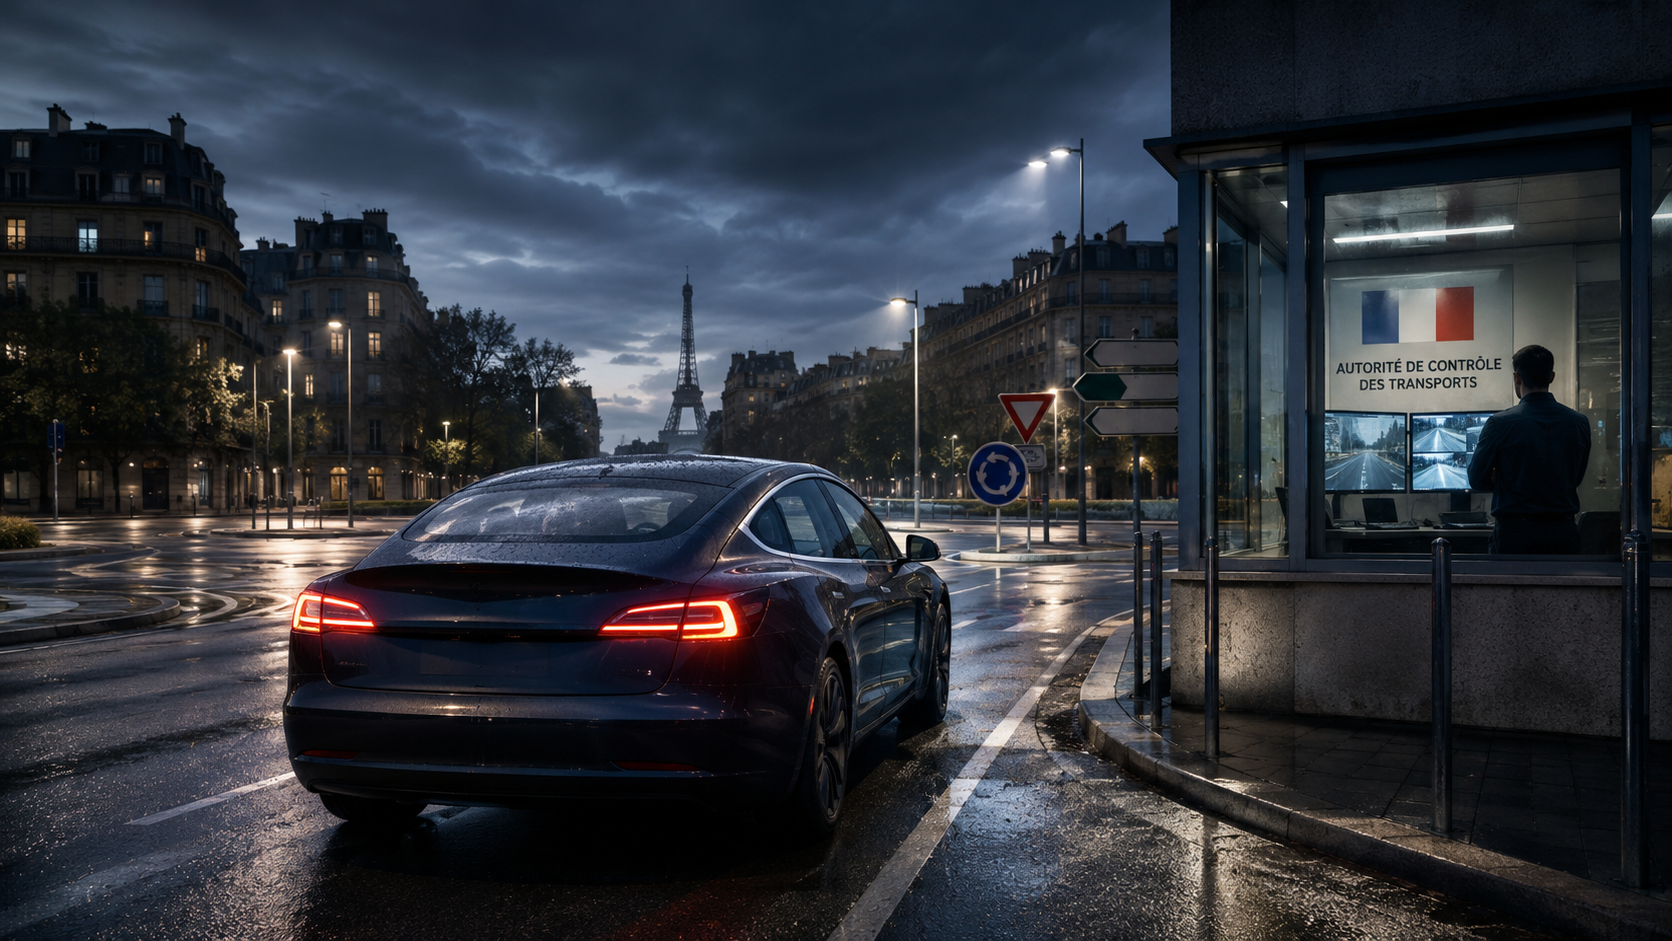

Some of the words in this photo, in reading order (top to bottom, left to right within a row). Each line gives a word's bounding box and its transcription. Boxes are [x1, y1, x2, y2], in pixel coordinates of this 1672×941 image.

[1336, 358, 1402, 374] AUTORITÉ
[1406, 360, 1424, 373] DE
[1428, 356, 1502, 372] CONTRÔLE
[1359, 379, 1385, 391] DES
[1389, 376, 1477, 389] TRANSPORTS
